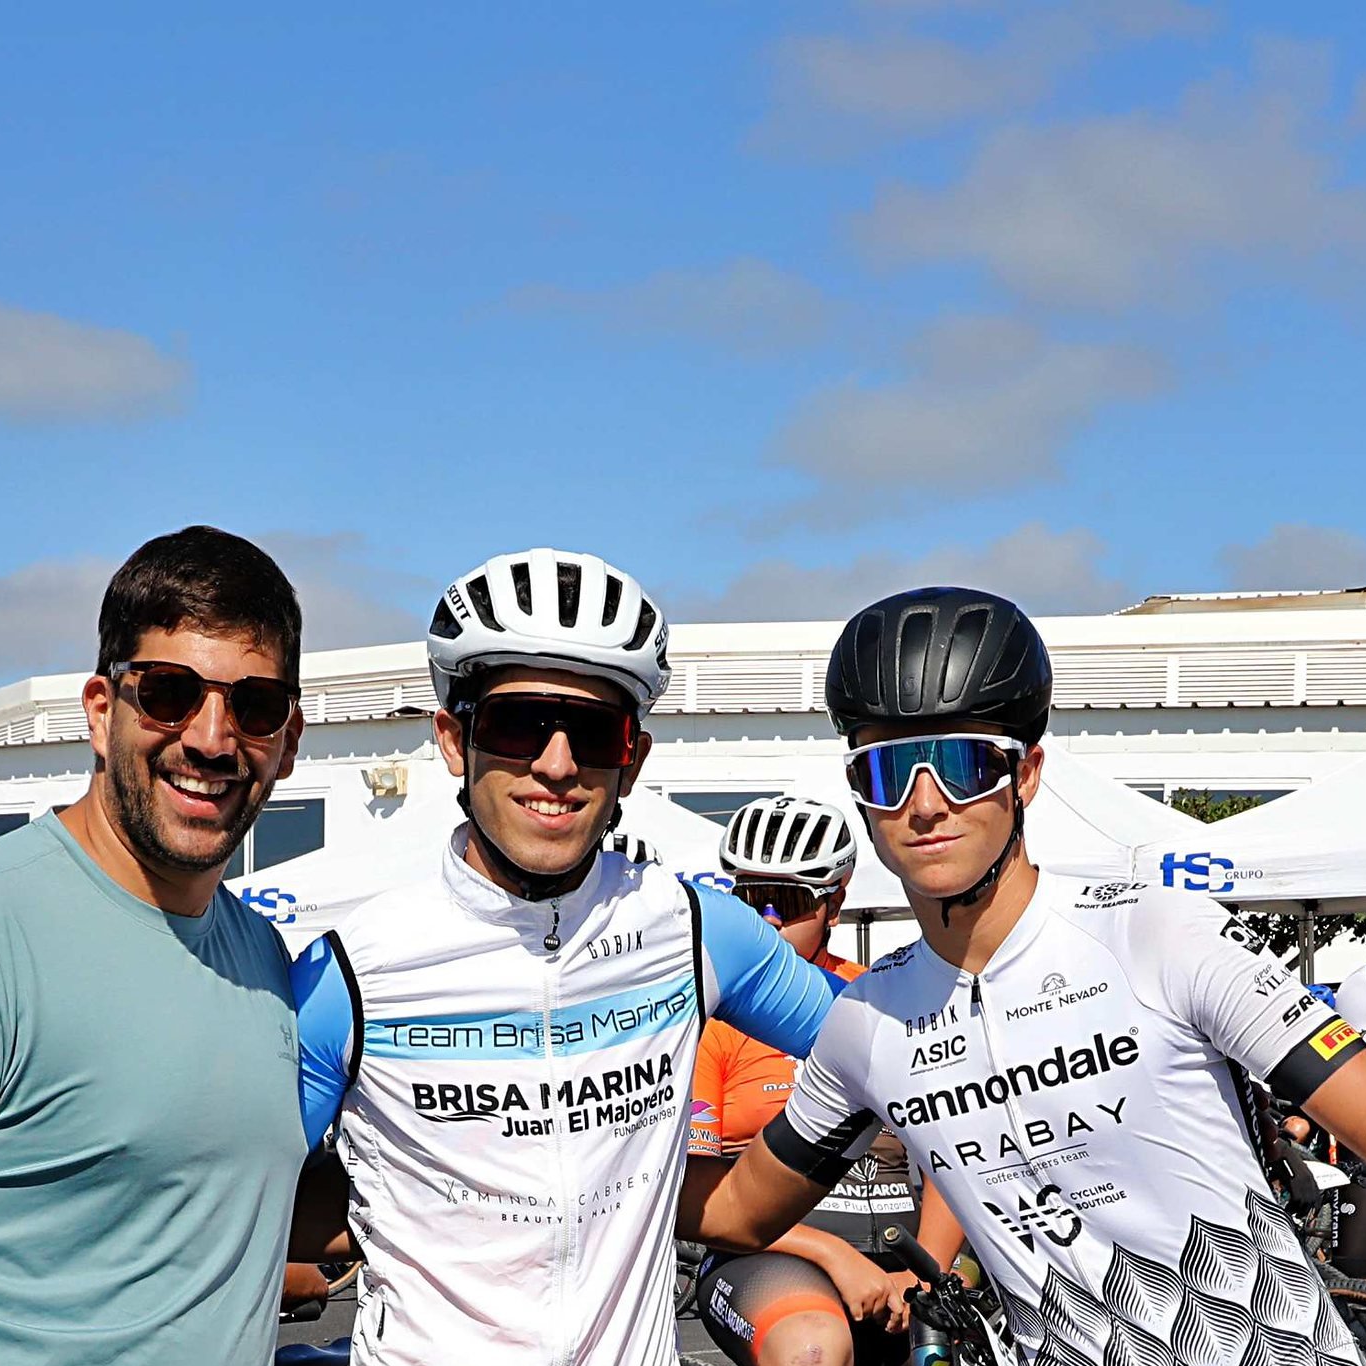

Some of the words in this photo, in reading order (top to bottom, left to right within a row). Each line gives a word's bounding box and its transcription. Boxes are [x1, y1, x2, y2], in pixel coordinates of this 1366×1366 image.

[1225, 869, 1264, 880] GRUPO
[288, 903, 318, 914] GRUPO
[384, 1024, 483, 1048] Team
[493, 1021, 583, 1048] Brisa
[591, 994, 687, 1038] Marina
[906, 1005, 959, 1038] GOBIK
[911, 1035, 967, 1069] ASIC
[412, 1083, 529, 1112] BRISA
[540, 1053, 673, 1110] MARINA
[887, 1033, 1140, 1128] cannondale
[501, 1116, 556, 1137] Juan
[569, 1109, 589, 1133] El
[596, 1084, 674, 1128] Majorero
[929, 1097, 1126, 1173] ARABAY
[985, 1171, 1019, 1186] coffee
[1060, 1149, 1090, 1166] team
[578, 1168, 664, 1206] CABRERA
[1070, 1182, 1114, 1201] CYCLING
[1075, 1190, 1127, 1210] BOUTIQUE
[501, 1213, 563, 1224] BEAUTY
[592, 1201, 622, 1218] HAIR
